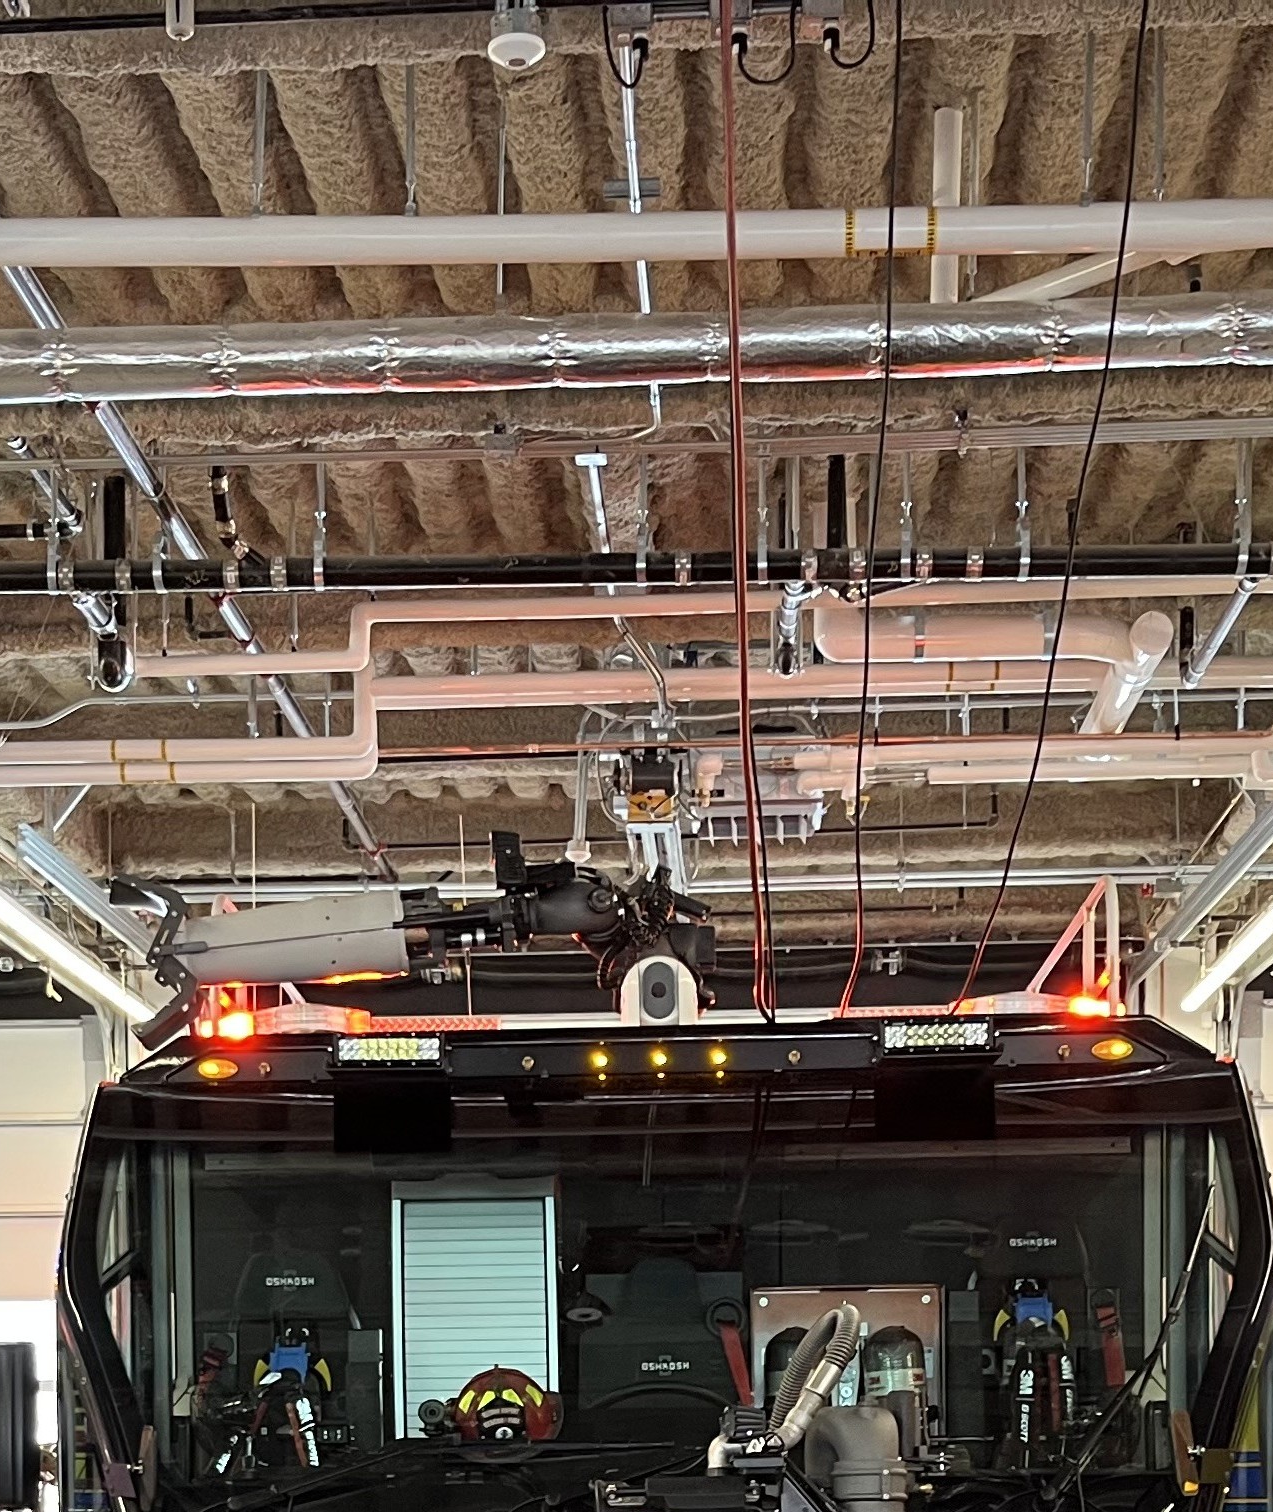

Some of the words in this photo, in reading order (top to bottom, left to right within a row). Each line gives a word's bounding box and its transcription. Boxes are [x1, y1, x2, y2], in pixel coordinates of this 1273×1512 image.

[1009, 1238, 1057, 1247] OSHKOSH
[266, 1277, 315, 1287] OSHKOSH
[641, 1361, 690, 1371] OSHKOSH
[1019, 1369, 1034, 1395] 3M
